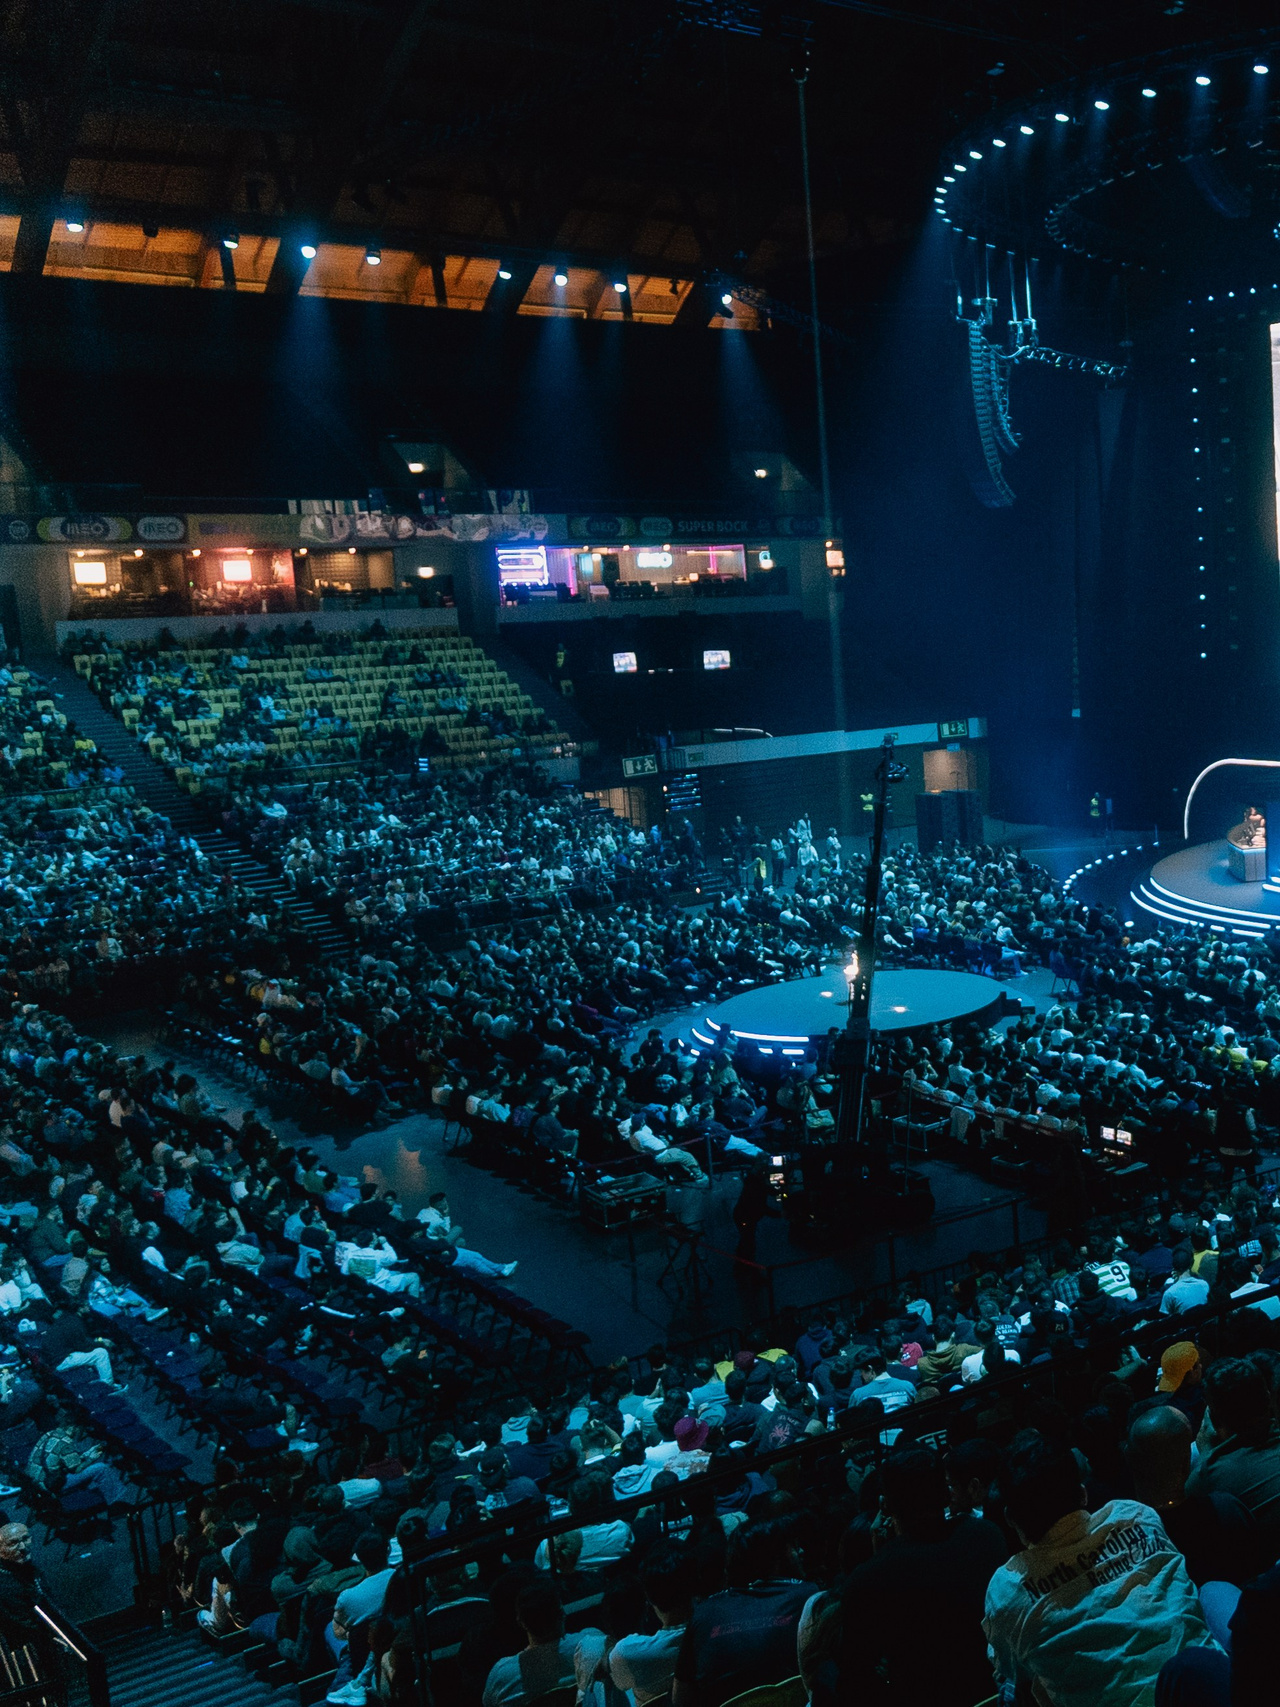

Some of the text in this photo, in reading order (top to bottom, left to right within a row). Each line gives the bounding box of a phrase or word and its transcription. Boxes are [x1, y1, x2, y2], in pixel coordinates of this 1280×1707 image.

[677, 520, 748, 533] SUPER BOCK
[1111, 1265, 1126, 1282] 9
[1022, 1524, 1147, 1603] North Carolina
[1088, 1530, 1165, 1587] Racing Club
